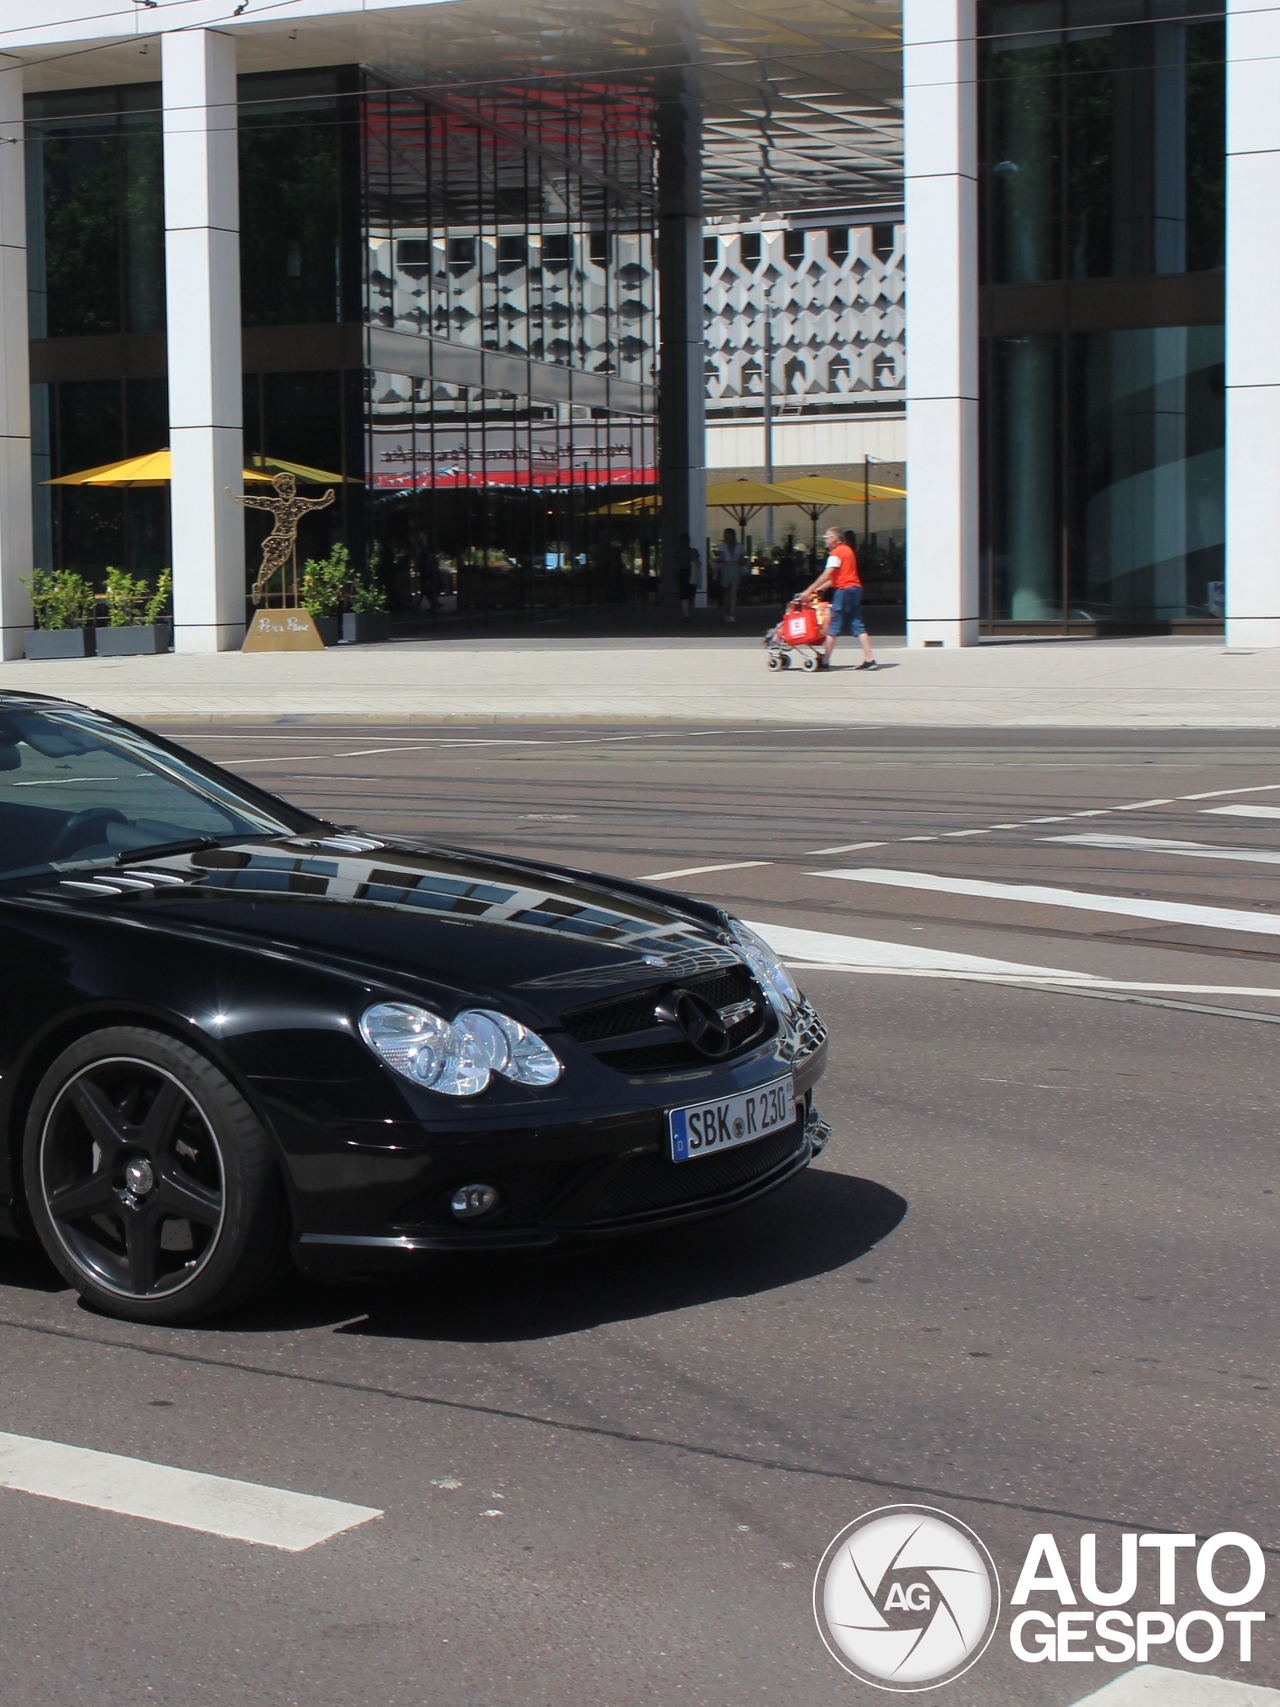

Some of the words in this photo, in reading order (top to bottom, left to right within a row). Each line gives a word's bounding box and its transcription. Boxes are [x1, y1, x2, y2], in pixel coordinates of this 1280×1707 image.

[688, 1104, 732, 1149] SBK
[745, 1097, 757, 1134] R
[760, 1086, 786, 1129] 230
[677, 1140, 684, 1151] D
